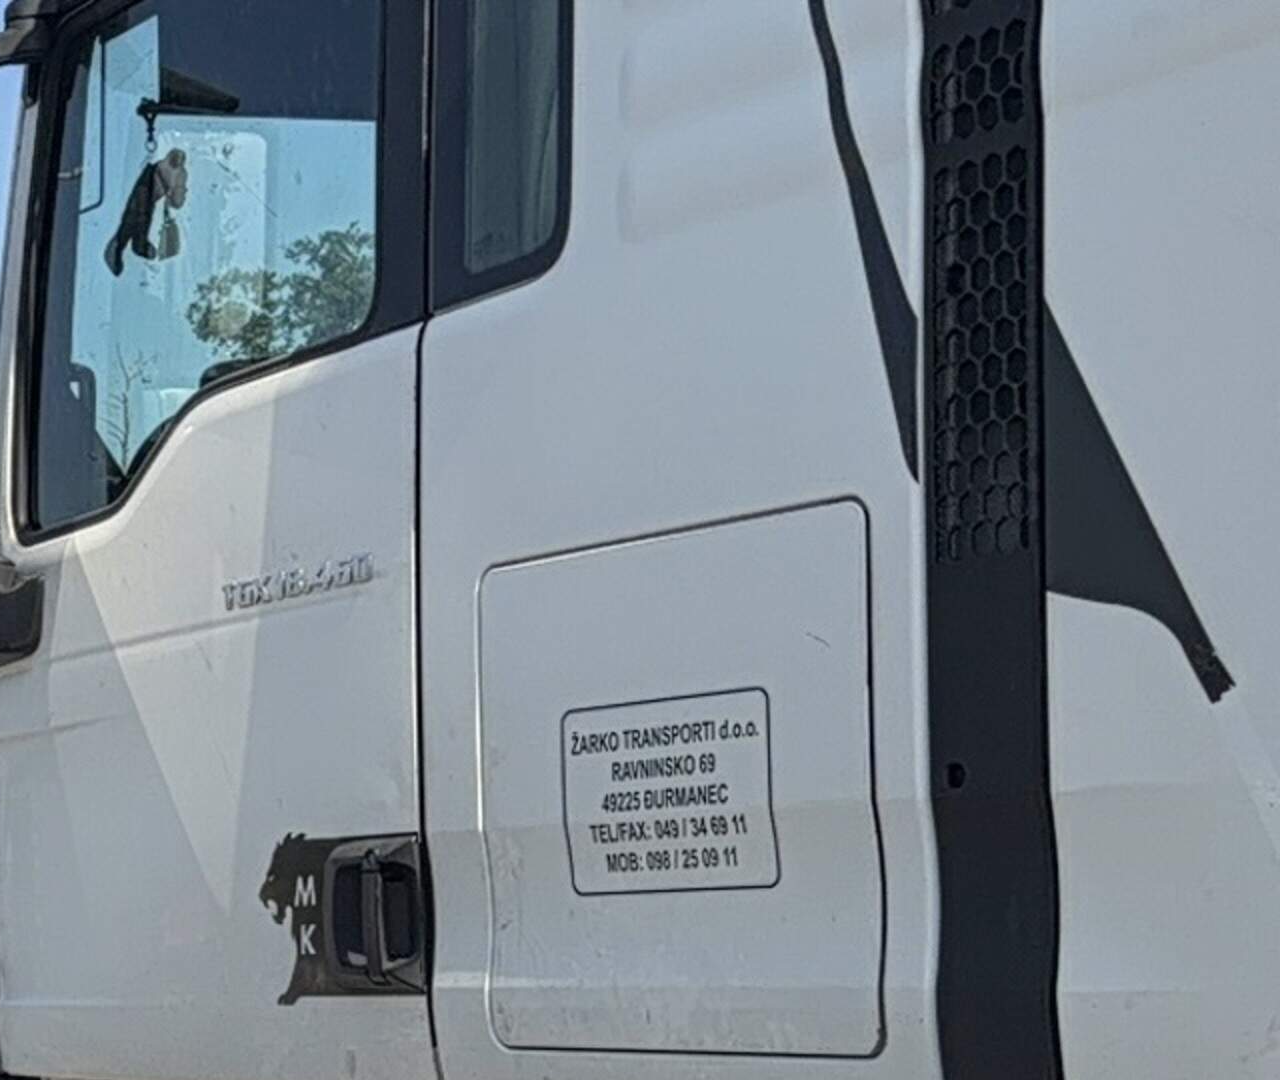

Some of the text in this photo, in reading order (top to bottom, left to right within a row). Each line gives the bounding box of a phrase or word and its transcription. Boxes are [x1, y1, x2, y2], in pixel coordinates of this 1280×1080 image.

[571, 720, 759, 756] ŽARKO TRANSPORTI d.o.o.
[611, 753, 717, 781] RAVNINSKO 69
[602, 793, 641, 813] 49225
[654, 819, 680, 839] 049
[690, 818, 708, 837] 34
[711, 816, 729, 835] 69
[732, 814, 748, 834] 11
[606, 853, 644, 873] MOB:
[646, 850, 671, 871] 098
[682, 849, 699, 868] 25
[703, 847, 720, 867] 09
[723, 846, 739, 866] 11
[294, 875, 316, 907] M
[300, 924, 316, 955] K
